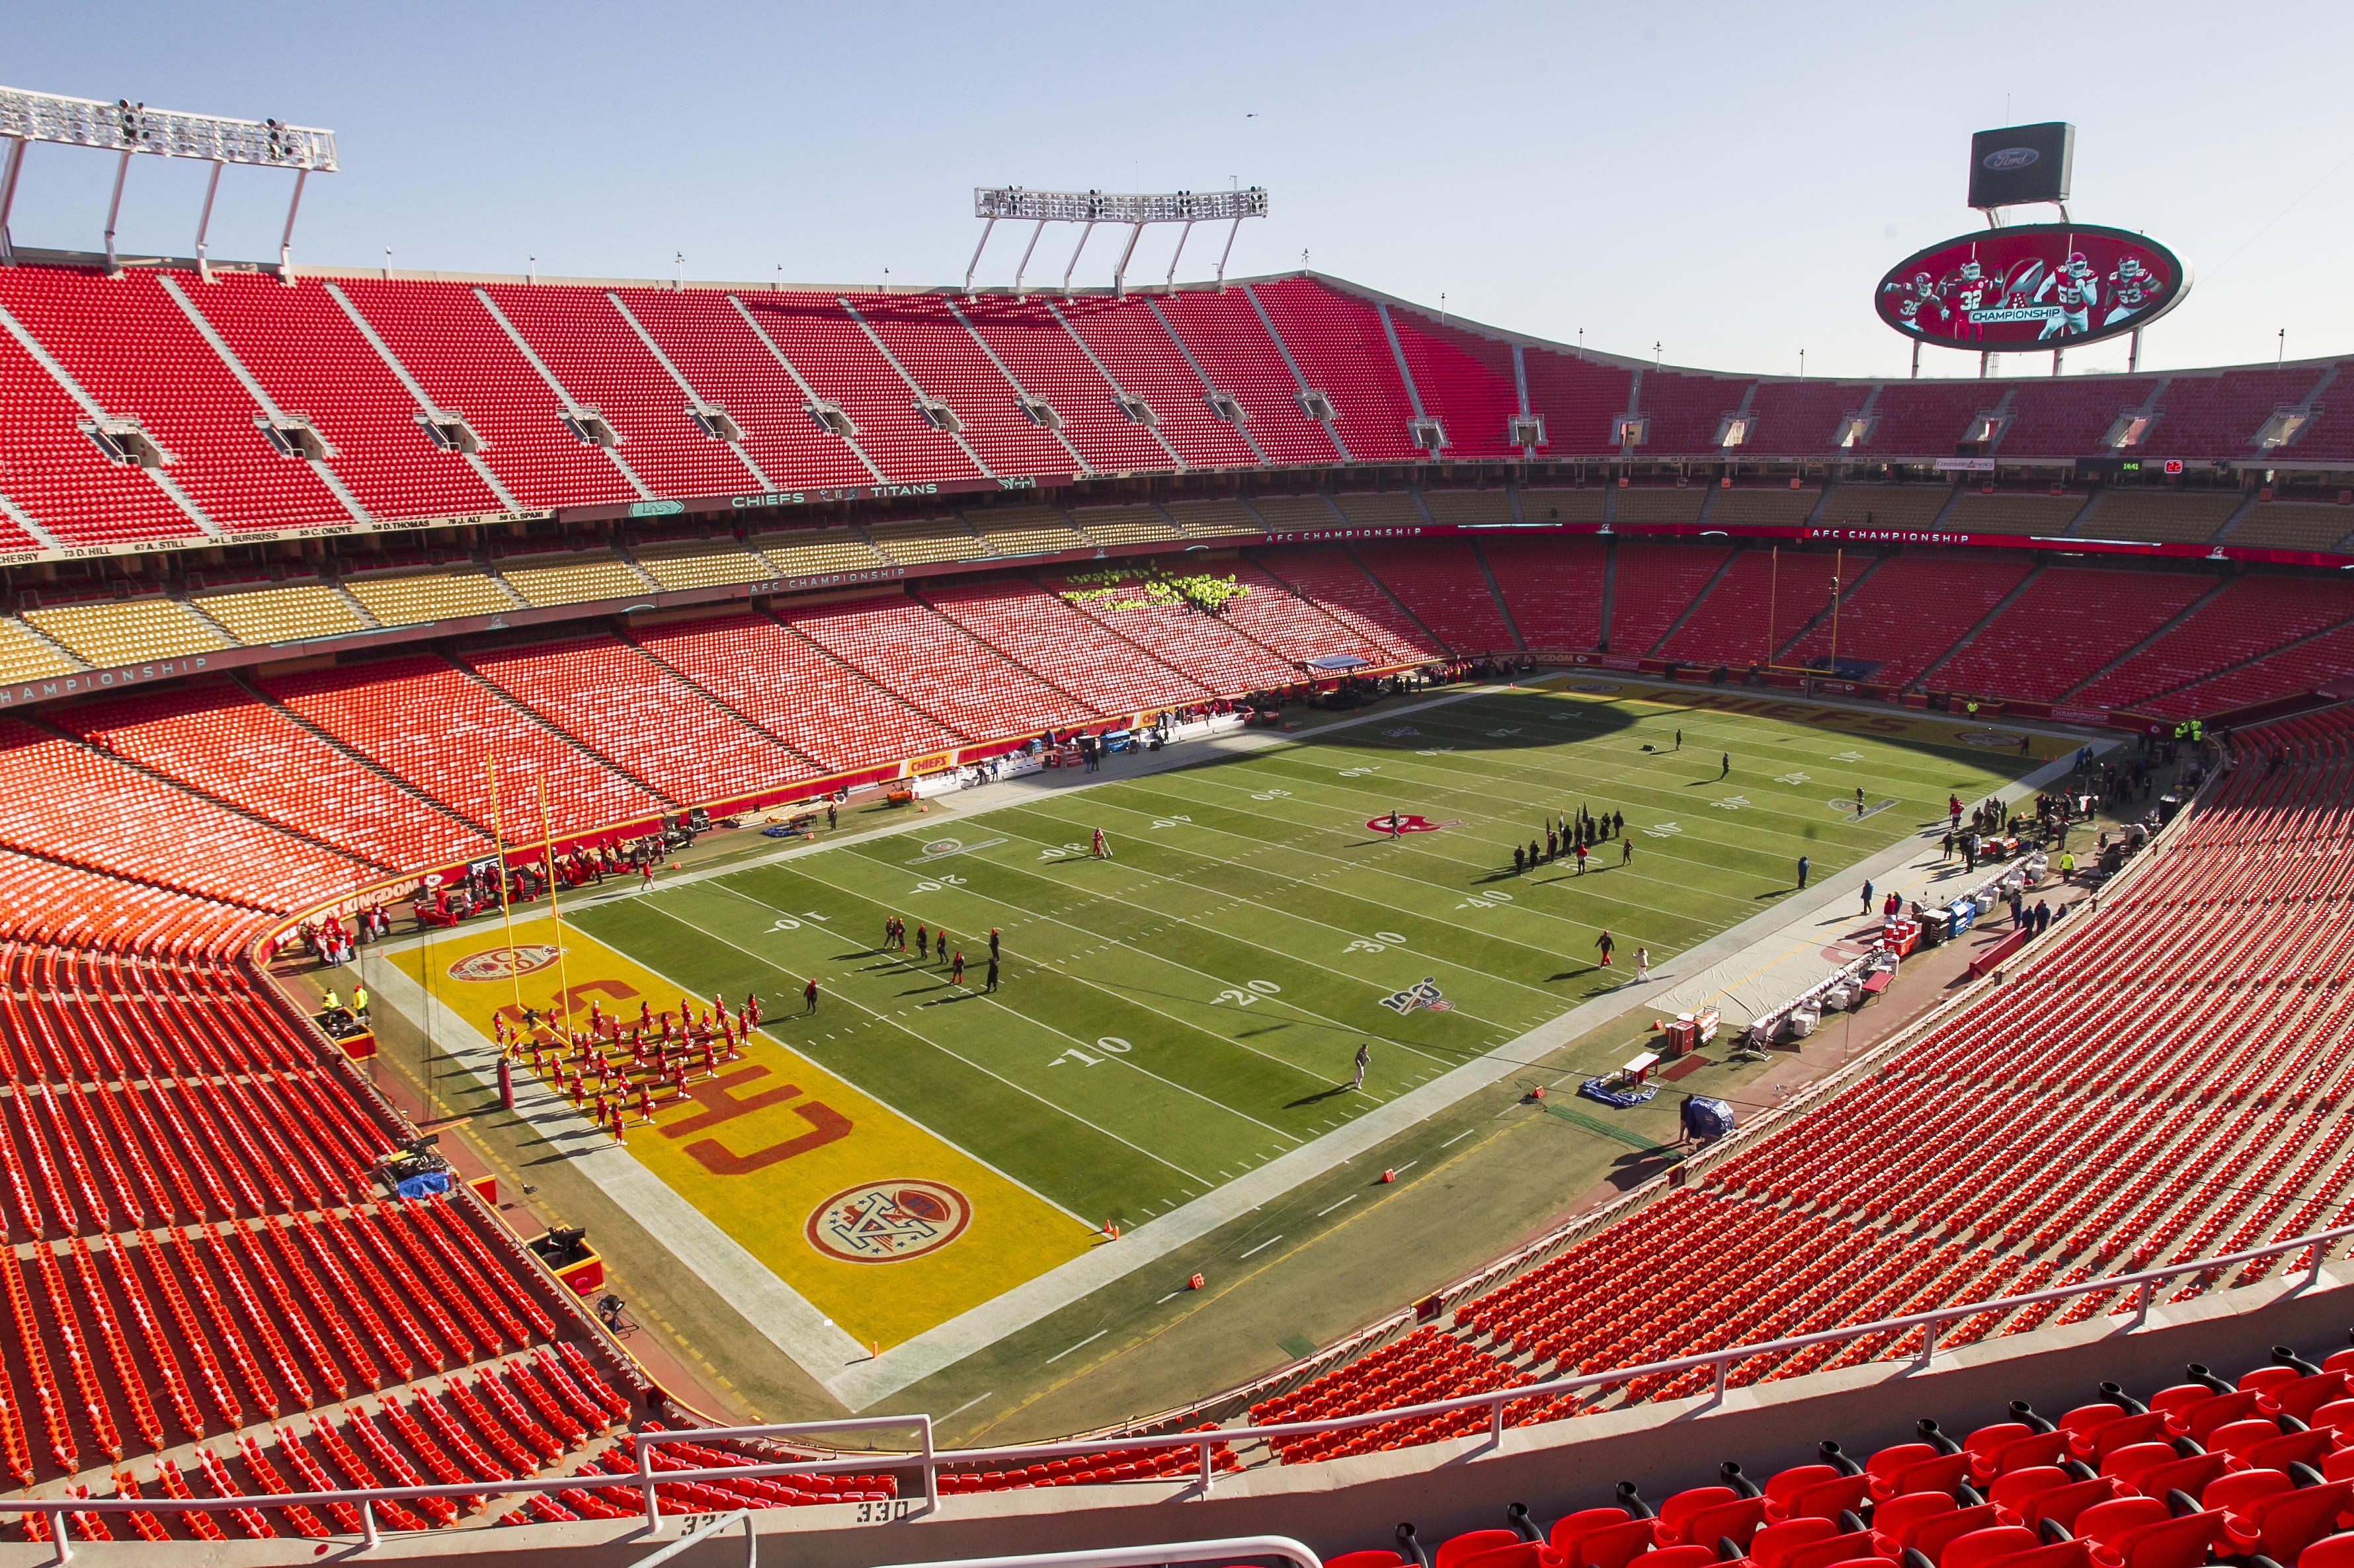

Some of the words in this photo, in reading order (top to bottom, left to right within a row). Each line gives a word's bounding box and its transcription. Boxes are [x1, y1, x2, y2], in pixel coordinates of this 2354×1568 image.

[1994, 151, 2027, 167] Ford
[1960, 290, 1982, 310] 32
[1972, 307, 2060, 321] CHAMPIONSHIP
[2168, 461, 2181, 471] 22
[870, 484, 938, 497] TITANS
[731, 492, 805, 508] CHIEFS
[322, 526, 353, 535] OKOYE
[391, 520, 430, 529] THOMAS
[231, 532, 278, 543] BURRUSS
[1266, 534, 1293, 543] AFC
[1303, 528, 1422, 541] CHAMPIONSHIP
[1812, 529, 1840, 538] AFC
[1849, 530, 1969, 543] CHAMPIONSHIP
[89, 547, 112, 555] HILL
[159, 540, 187, 549] STILL
[751, 582, 780, 594] AFC
[789, 568, 905, 588] CHAMPIONSHIP
[2052, 709, 2109, 721] CHAMPIONSHIP
[911, 755, 947, 772] CHIEFS
[1774, 772, 1810, 785] 20
[1250, 789, 1293, 801] 50
[1711, 797, 1750, 810] 30
[1154, 814, 1192, 829] 40
[1642, 824, 1683, 838] 40
[1043, 842, 1090, 858] 30
[920, 874, 967, 892] 20
[343, 880, 420, 916] KINGDOM
[1466, 890, 1514, 910] 40
[774, 910, 832, 929] 10
[1351, 931, 1406, 954] 30
[1219, 979, 1282, 1007] 20
[1062, 1036, 1132, 1068] 10
[856, 1501, 909, 1523] 330
